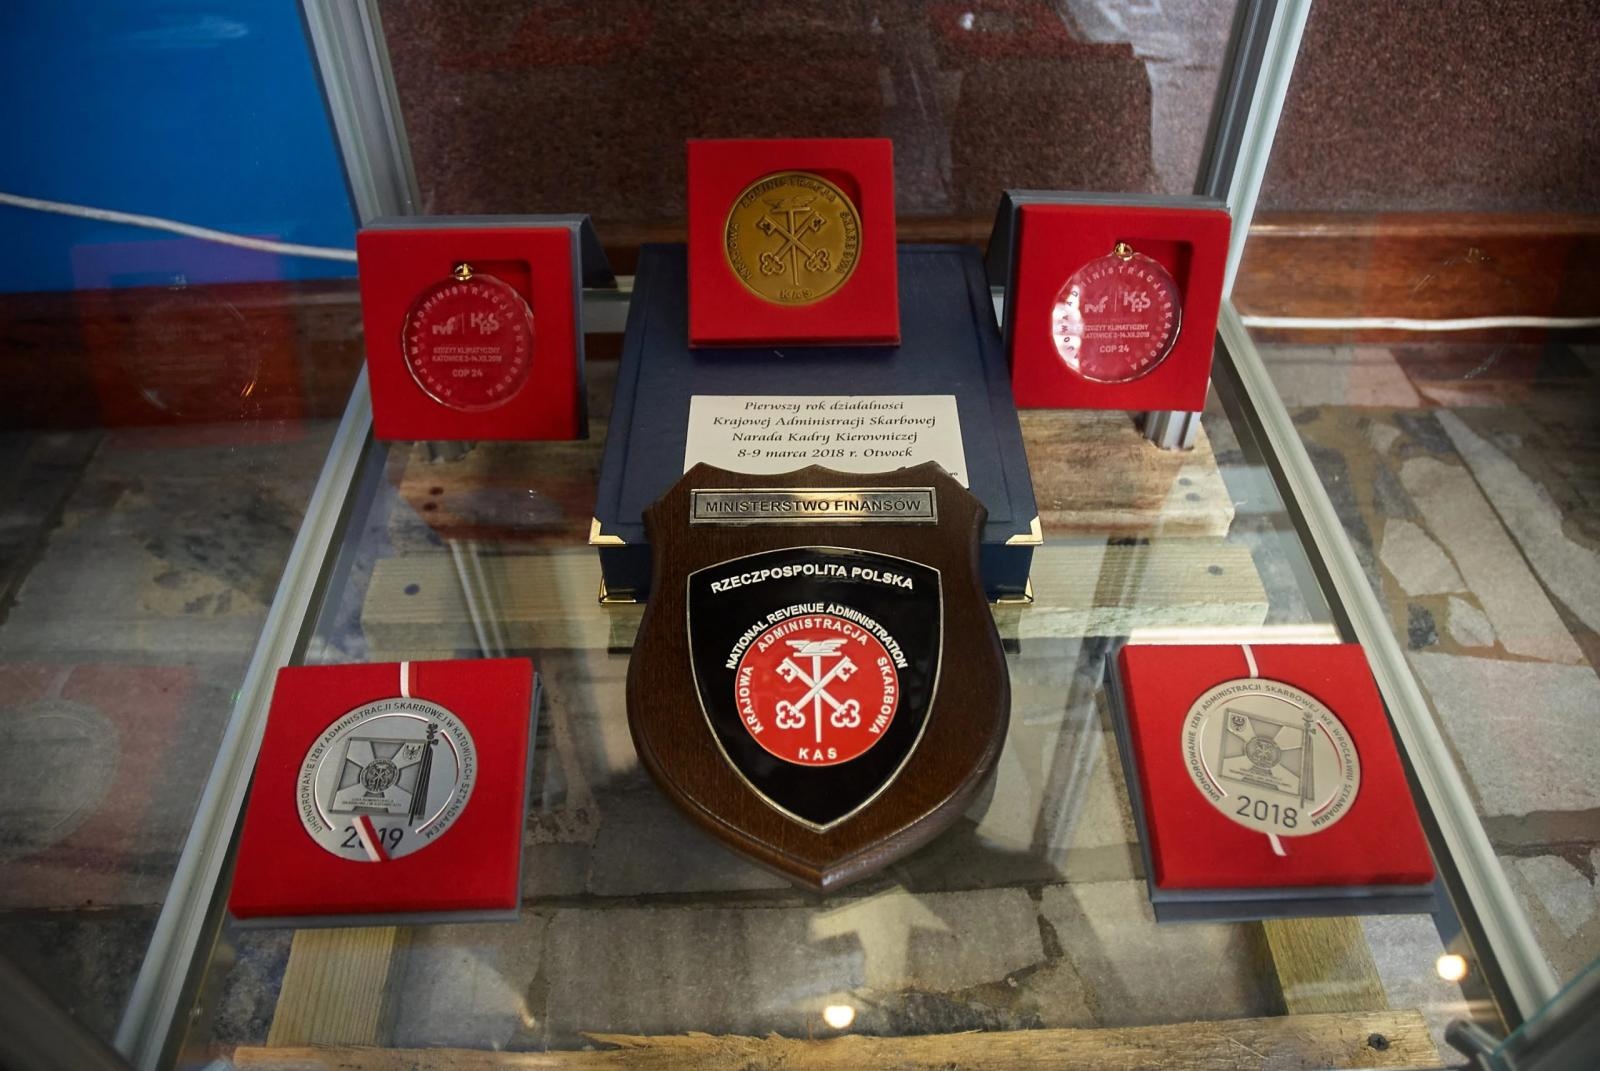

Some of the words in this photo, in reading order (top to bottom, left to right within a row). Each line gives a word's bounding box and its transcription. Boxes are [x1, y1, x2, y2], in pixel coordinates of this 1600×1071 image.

[413, 286, 514, 328] ADMINISTRACJA
[1100, 345, 1117, 353] COP
[1118, 344, 1129, 353] 24
[452, 369, 470, 377] COP
[471, 369, 483, 377] 24
[744, 401, 801, 414] Pierwszy
[805, 400, 826, 410] rok
[713, 416, 771, 429] Krajowej
[775, 415, 864, 429] Administracji
[869, 415, 936, 429] Skarbowej
[732, 431, 782, 441] Narada
[788, 431, 830, 445] Kadry
[835, 431, 917, 444] Kierowniczej
[737, 448, 761, 458] 8-9
[766, 449, 807, 458] marca
[811, 448, 844, 458] 2018
[849, 449, 858, 458] r.
[863, 446, 913, 457] Otwock
[705, 500, 830, 513] MINISTERSTWO
[834, 498, 921, 512] FINANSÓW
[710, 564, 847, 594] RZECZPOSPOLITA
[851, 566, 914, 590] POLSKA
[726, 620, 768, 670] NATIONAL
[766, 603, 825, 625] REVENUE
[826, 604, 908, 669] ADMINISTRATION
[738, 666, 765, 735] KRAJOWA
[756, 618, 868, 653] ADMINISTRACJA
[868, 656, 896, 735] SKARBOWA
[1202, 683, 1262, 712] ADMINISTRACJI
[1265, 684, 1319, 713] SKARBOWEJ
[324, 703, 393, 744] ADMINISTRACJI
[393, 702, 448, 722] SKARBOWEJ
[445, 718, 456, 729] W
[1191, 711, 1205, 730] IZBY
[1320, 712, 1334, 726] WE
[311, 743, 327, 762] IZBY
[452, 725, 473, 780] KATOWICACH
[798, 747, 838, 761] KAS
[1187, 731, 1221, 802] UHONOROWANIE
[301, 763, 323, 834] UHONOROWANIE
[1311, 784, 1353, 828] SZTANDAREM
[425, 783, 470, 840] SZTANDAREM
[1236, 795, 1298, 829] 2018
